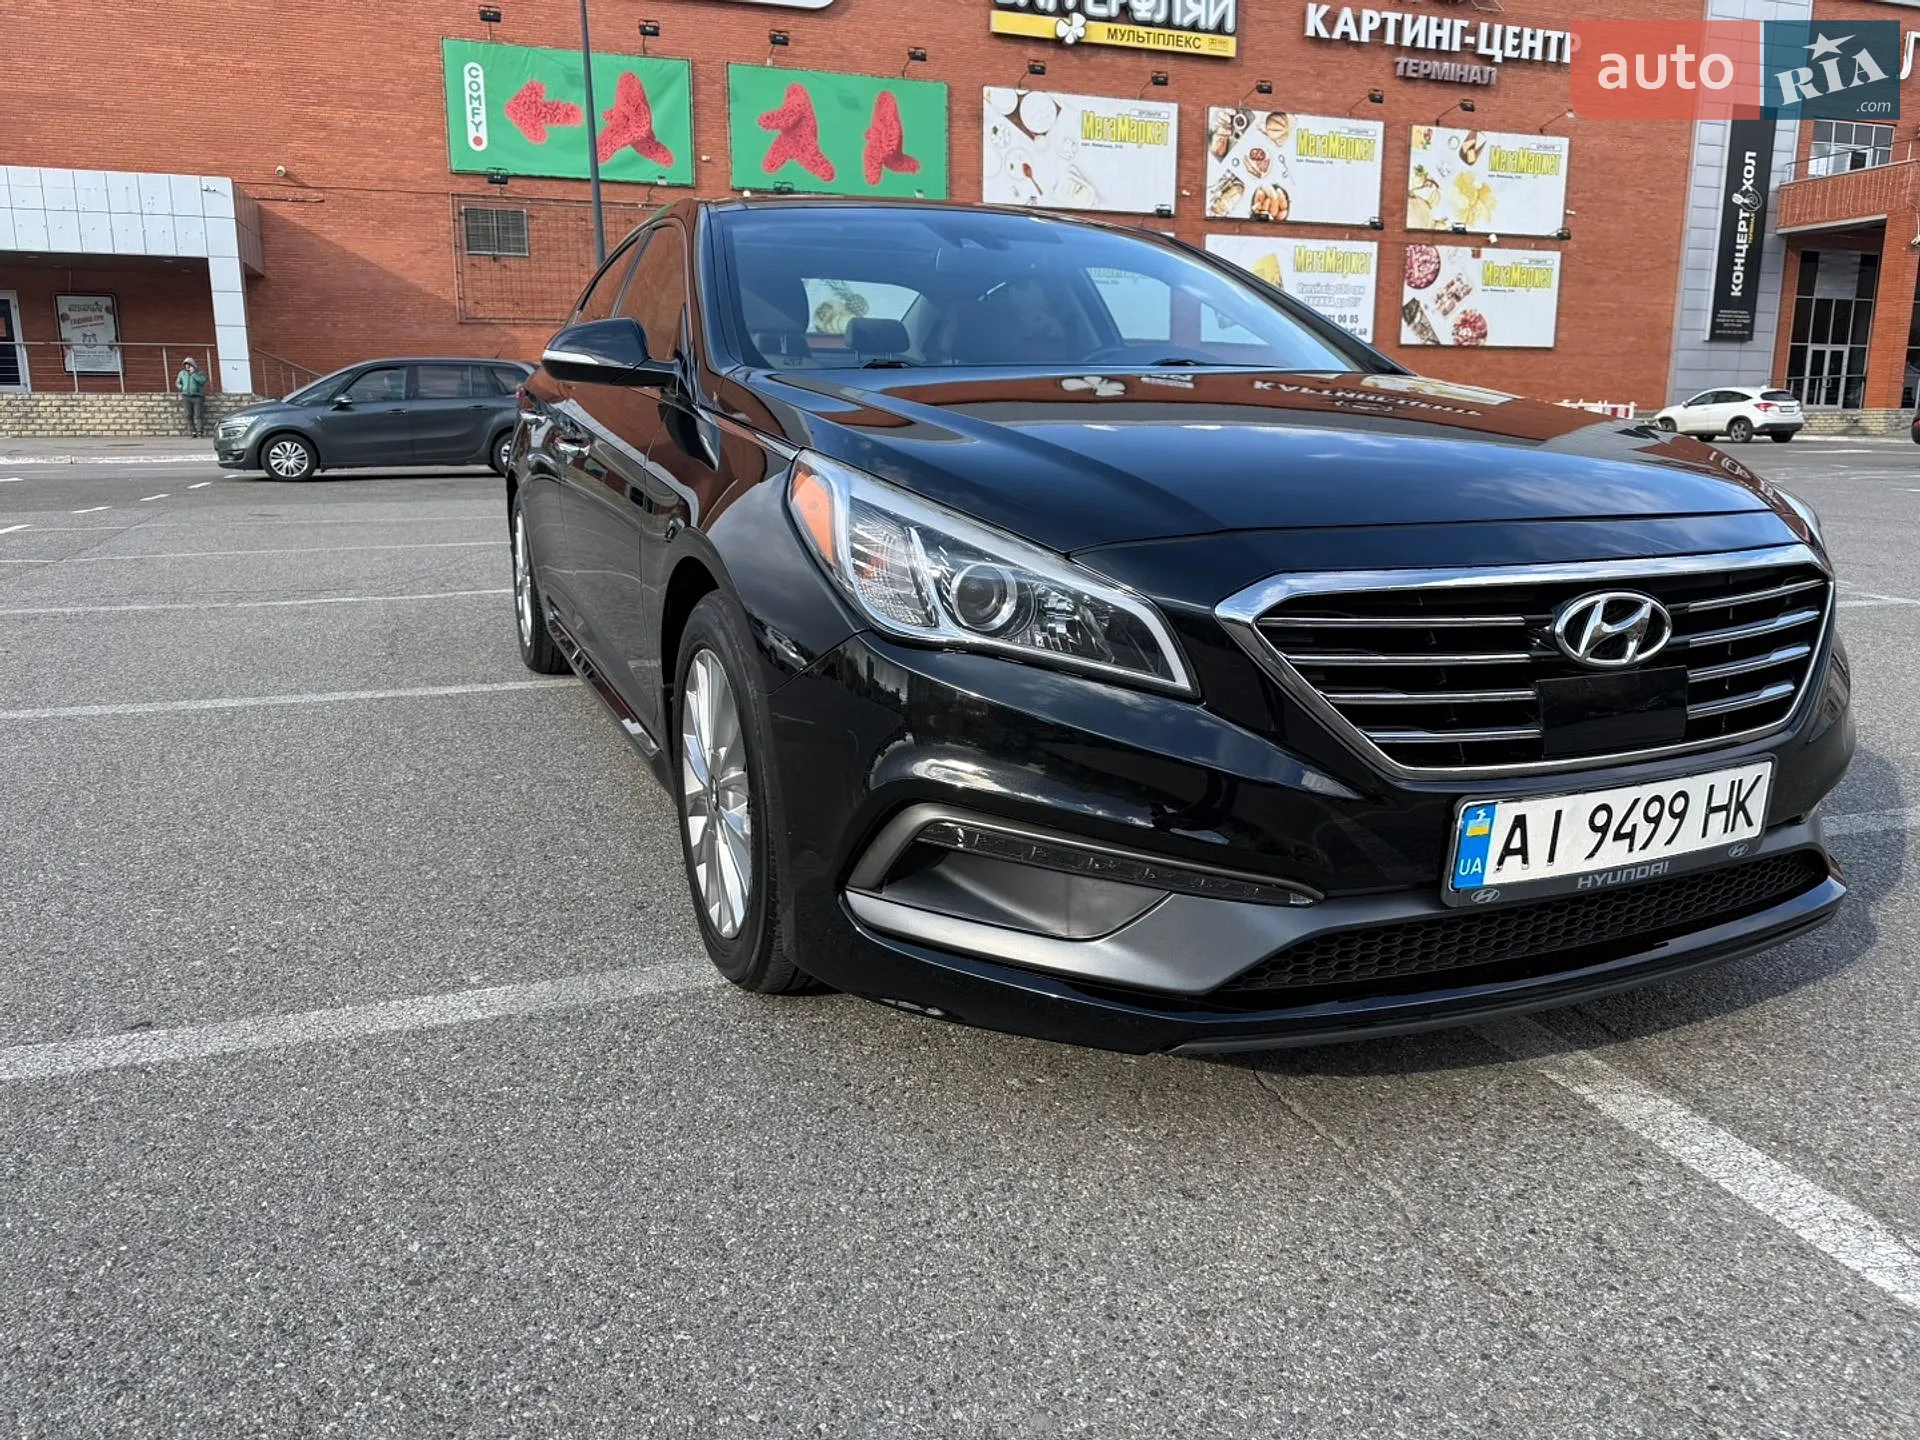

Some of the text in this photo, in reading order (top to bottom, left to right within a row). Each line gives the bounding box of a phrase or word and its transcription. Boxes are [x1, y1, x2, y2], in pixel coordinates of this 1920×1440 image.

[1106, 27, 1202, 49] МУЛЬТІПЛЕКС
[1304, 2, 1582, 64] КАРТИНГ-ЦЕНТР
[1395, 56, 1498, 85] ТЕРМІНАЛ
[467, 66, 483, 133] COMFY
[1081, 110, 1169, 149] МегаМаркет
[1296, 128, 1376, 164] МегаМаркет
[1488, 145, 1561, 178] МегаМаркет
[1730, 208, 1751, 297] КОНЦЕРТ
[1741, 150, 1757, 192] ХОЛ
[1293, 245, 1372, 278] МегаМаркет
[1482, 260, 1553, 292] МегаМаркет
[1494, 774, 1763, 874] AI 9499 HK
[1459, 857, 1482, 876] UA
[1577, 860, 1670, 889] HYUNDAI
